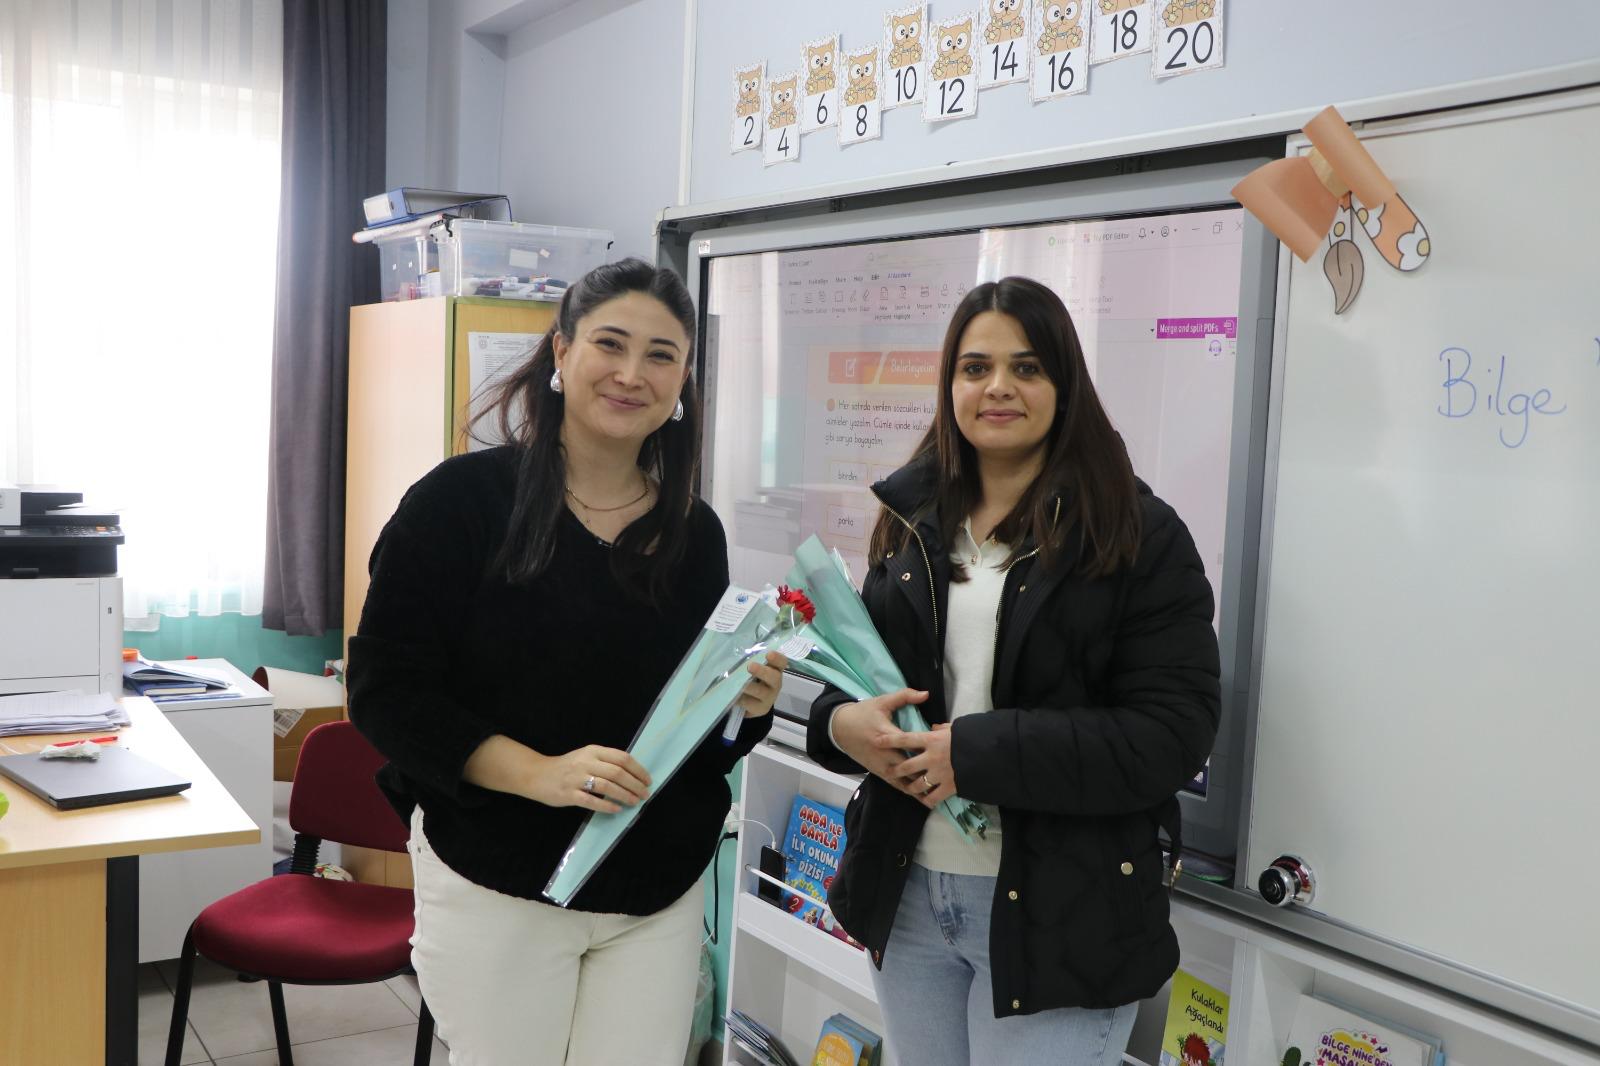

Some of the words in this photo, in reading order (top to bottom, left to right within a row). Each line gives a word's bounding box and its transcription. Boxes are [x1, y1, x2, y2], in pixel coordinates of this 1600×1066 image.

[1111, 9, 1138, 54] 18
[1165, 21, 1214, 70] 20
[992, 41, 1018, 80] 14
[1049, 51, 1074, 92] 16
[895, 65, 917, 102] 10
[939, 78, 965, 115] 12
[816, 93, 828, 124] 6
[856, 104, 868, 136] 8
[743, 115, 755, 145] 2
[777, 127, 790, 157] 4
[1159, 323, 1177, 335] Merge
[1178, 323, 1189, 333] and
[1190, 322, 1203, 334] split
[1203, 322, 1219, 333] PDFs
[838, 399, 849, 410] Her
[1437, 346, 1567, 449] Bilge
[799, 805, 828, 829] ARDA
[828, 819, 843, 837] İLE
[799, 821, 839, 851] DAMLA
[791, 834, 806, 855] İLK
[808, 846, 839, 872] OKUMA
[798, 859, 825, 882] DİZİSİ
[790, 897, 800, 910] 2
[1191, 987, 1225, 1015] Kulaklar
[1185, 1004, 1225, 1034] Ağaçlandı
[1321, 1034, 1350, 1055] BİLGE
